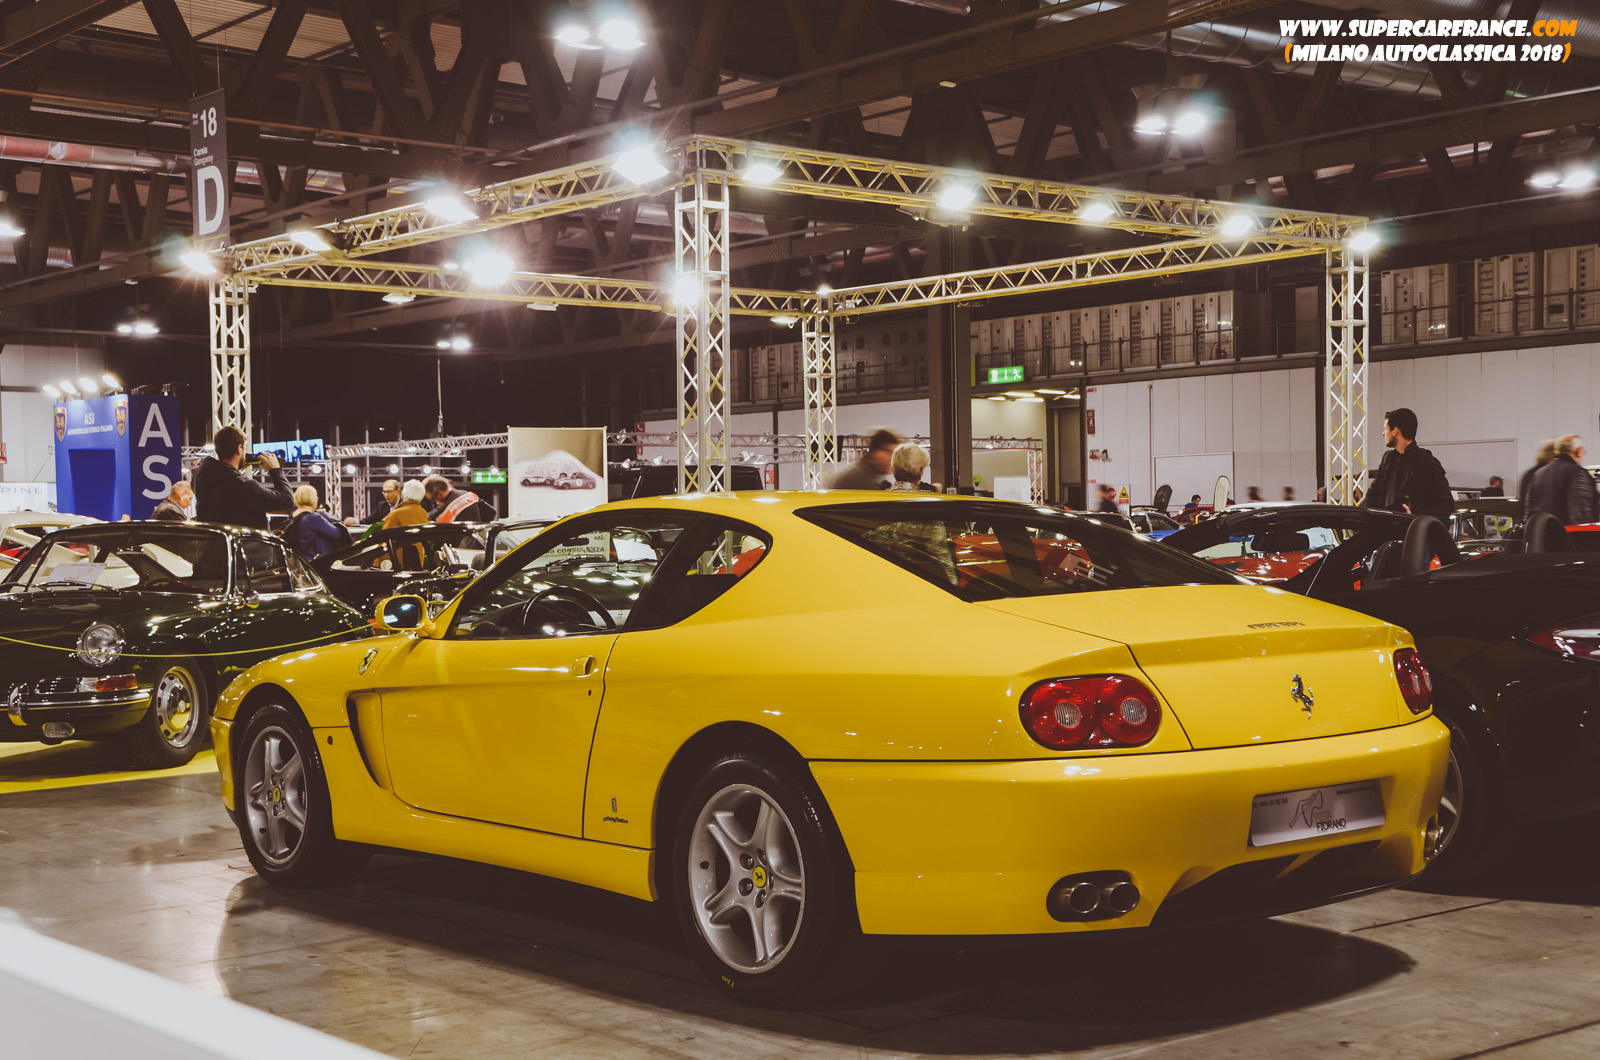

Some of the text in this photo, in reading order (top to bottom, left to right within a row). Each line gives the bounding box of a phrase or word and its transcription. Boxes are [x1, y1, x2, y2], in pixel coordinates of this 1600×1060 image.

[200, 107, 217, 138] 18
[193, 146, 208, 157] Corsia
[193, 155, 214, 167] Gangway
[197, 165, 224, 235] D
[84, 412, 95, 425] ASI
[1316, 818, 1347, 831] FIORANO
